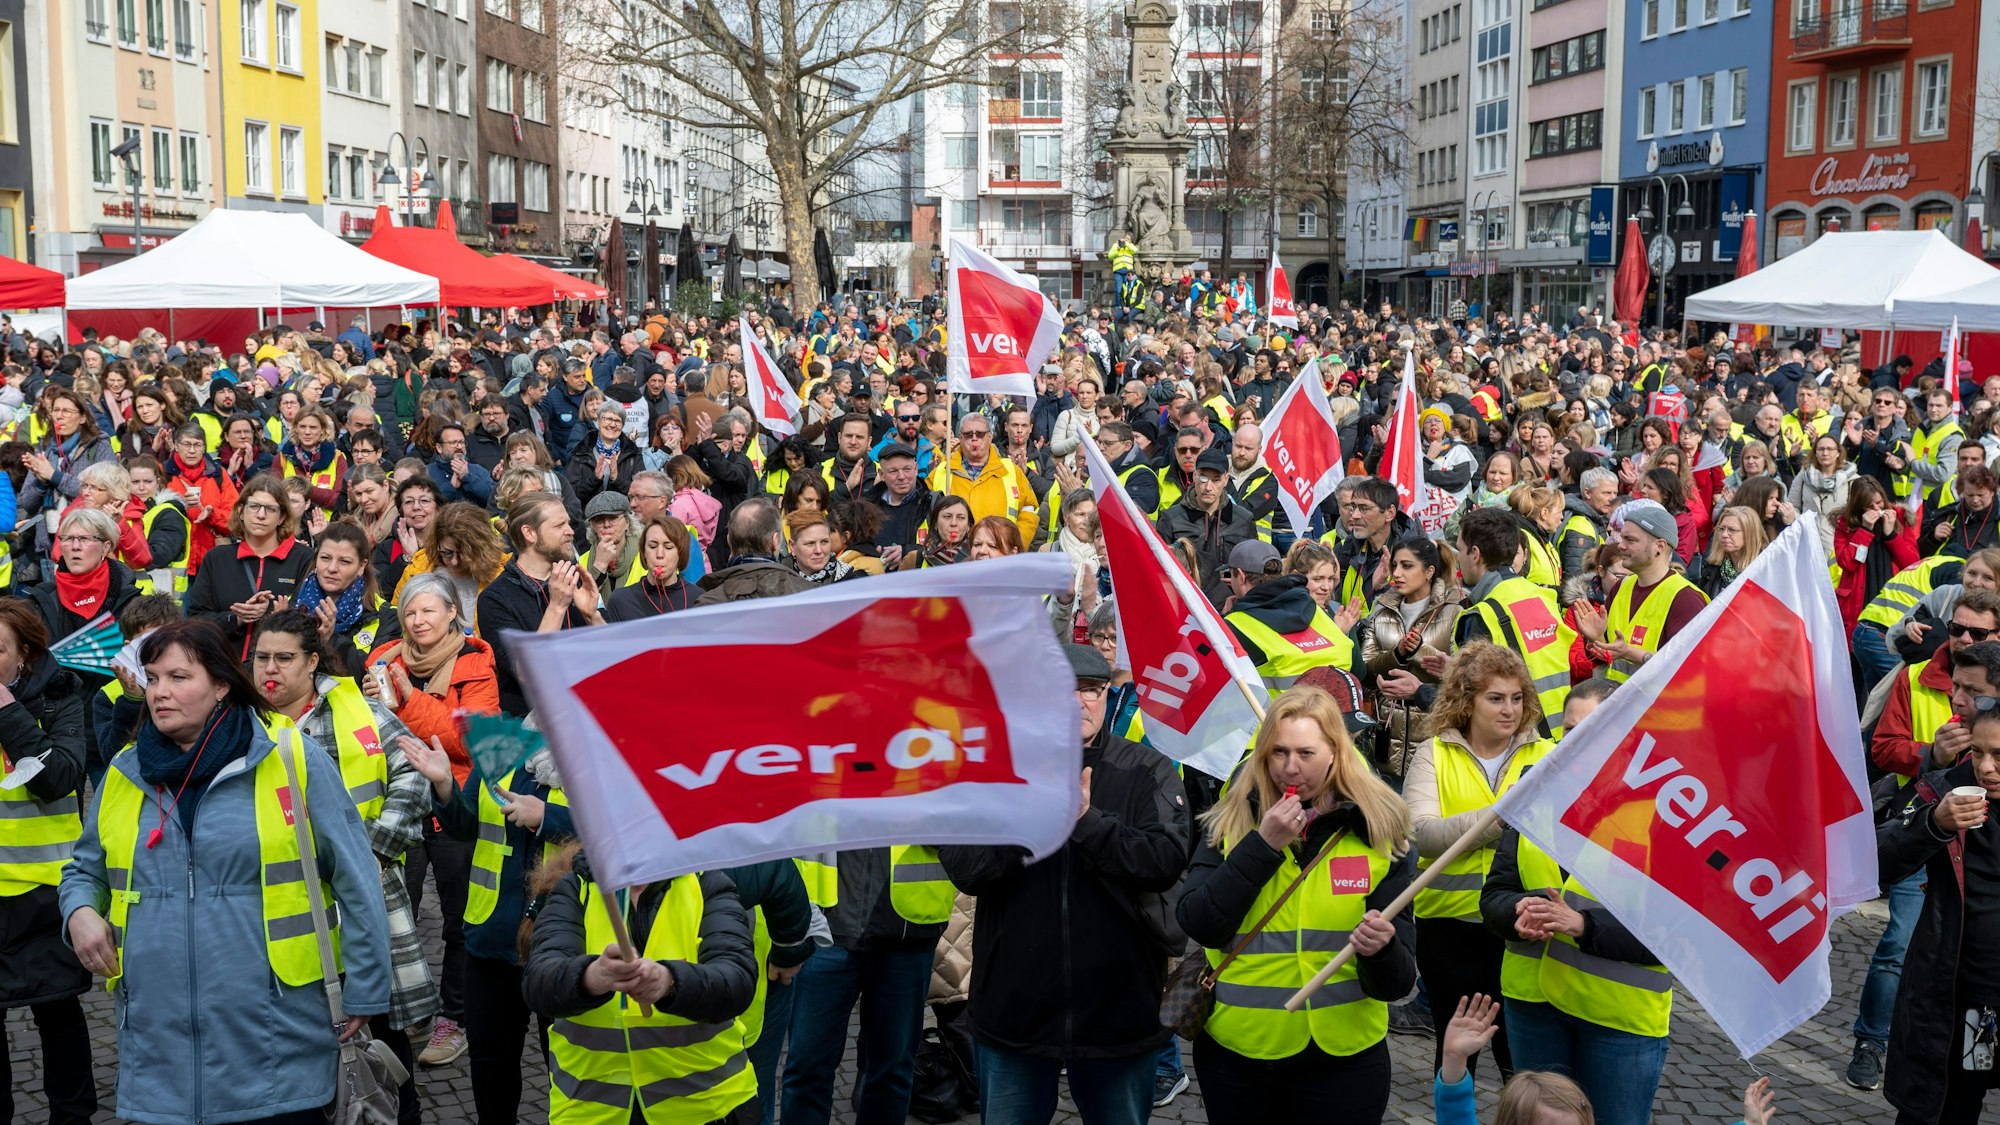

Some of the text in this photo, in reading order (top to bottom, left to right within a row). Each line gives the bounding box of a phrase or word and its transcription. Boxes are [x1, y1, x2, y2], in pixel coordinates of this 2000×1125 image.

[1810, 153, 1909, 196] Chocolaterie
[688, 146, 697, 215] HOTEL
[400, 200, 427, 208] KIOSK
[1721, 211, 1745, 222] Gaffel
[1590, 221, 1611, 231] Gaffel
[1273, 430, 1314, 505] ver.di
[74, 596, 96, 607] ver.di
[1523, 623, 1557, 641] ver.di
[1295, 637, 1328, 648] ver.di
[1622, 731, 1827, 945] ver.di
[1333, 878, 1369, 889] ver.di
